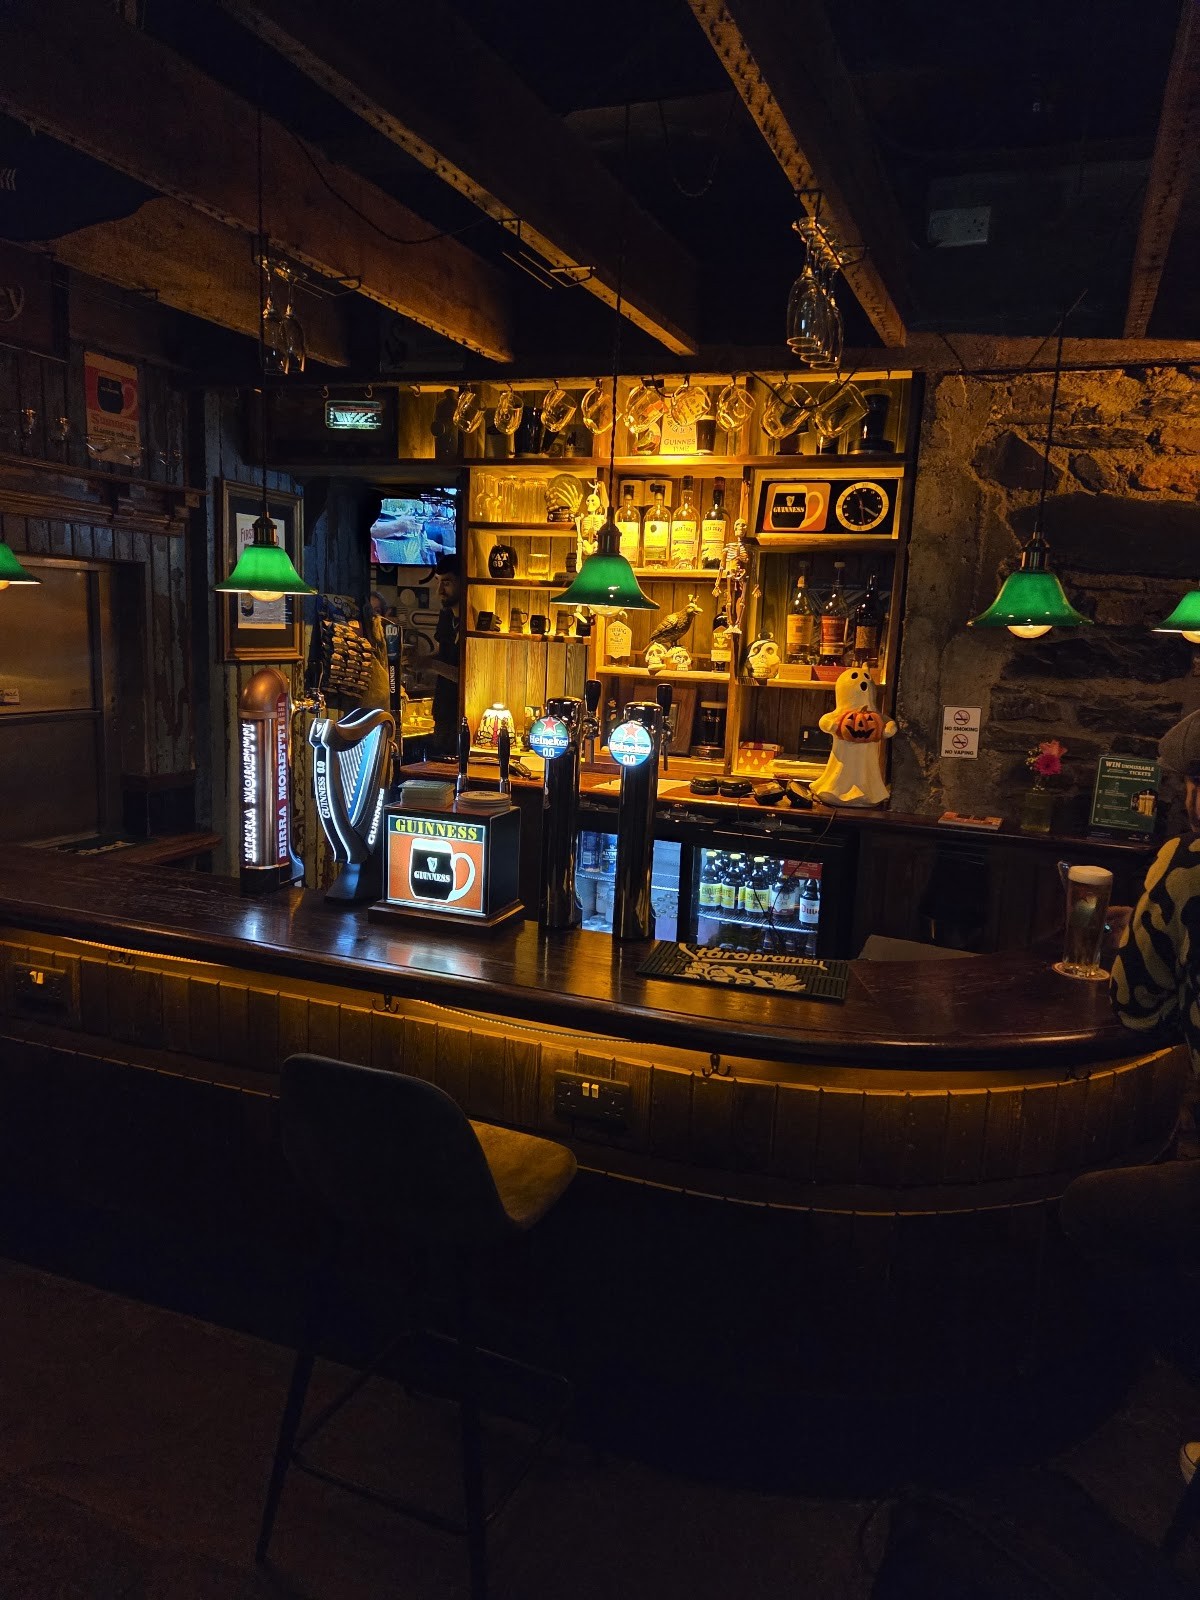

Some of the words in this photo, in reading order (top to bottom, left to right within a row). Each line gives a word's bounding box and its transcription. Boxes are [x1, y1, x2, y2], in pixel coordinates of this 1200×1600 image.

[529, 734, 569, 747] Heineken
[277, 724, 288, 801] MORETTI
[1105, 760, 1121, 768] WIN
[318, 776, 331, 819] GUINNESS
[279, 805, 288, 859] BIRRA
[367, 787, 385, 845] GUINNESS
[395, 818, 478, 841] GUINNESS
[413, 870, 451, 884] GUINNESS
